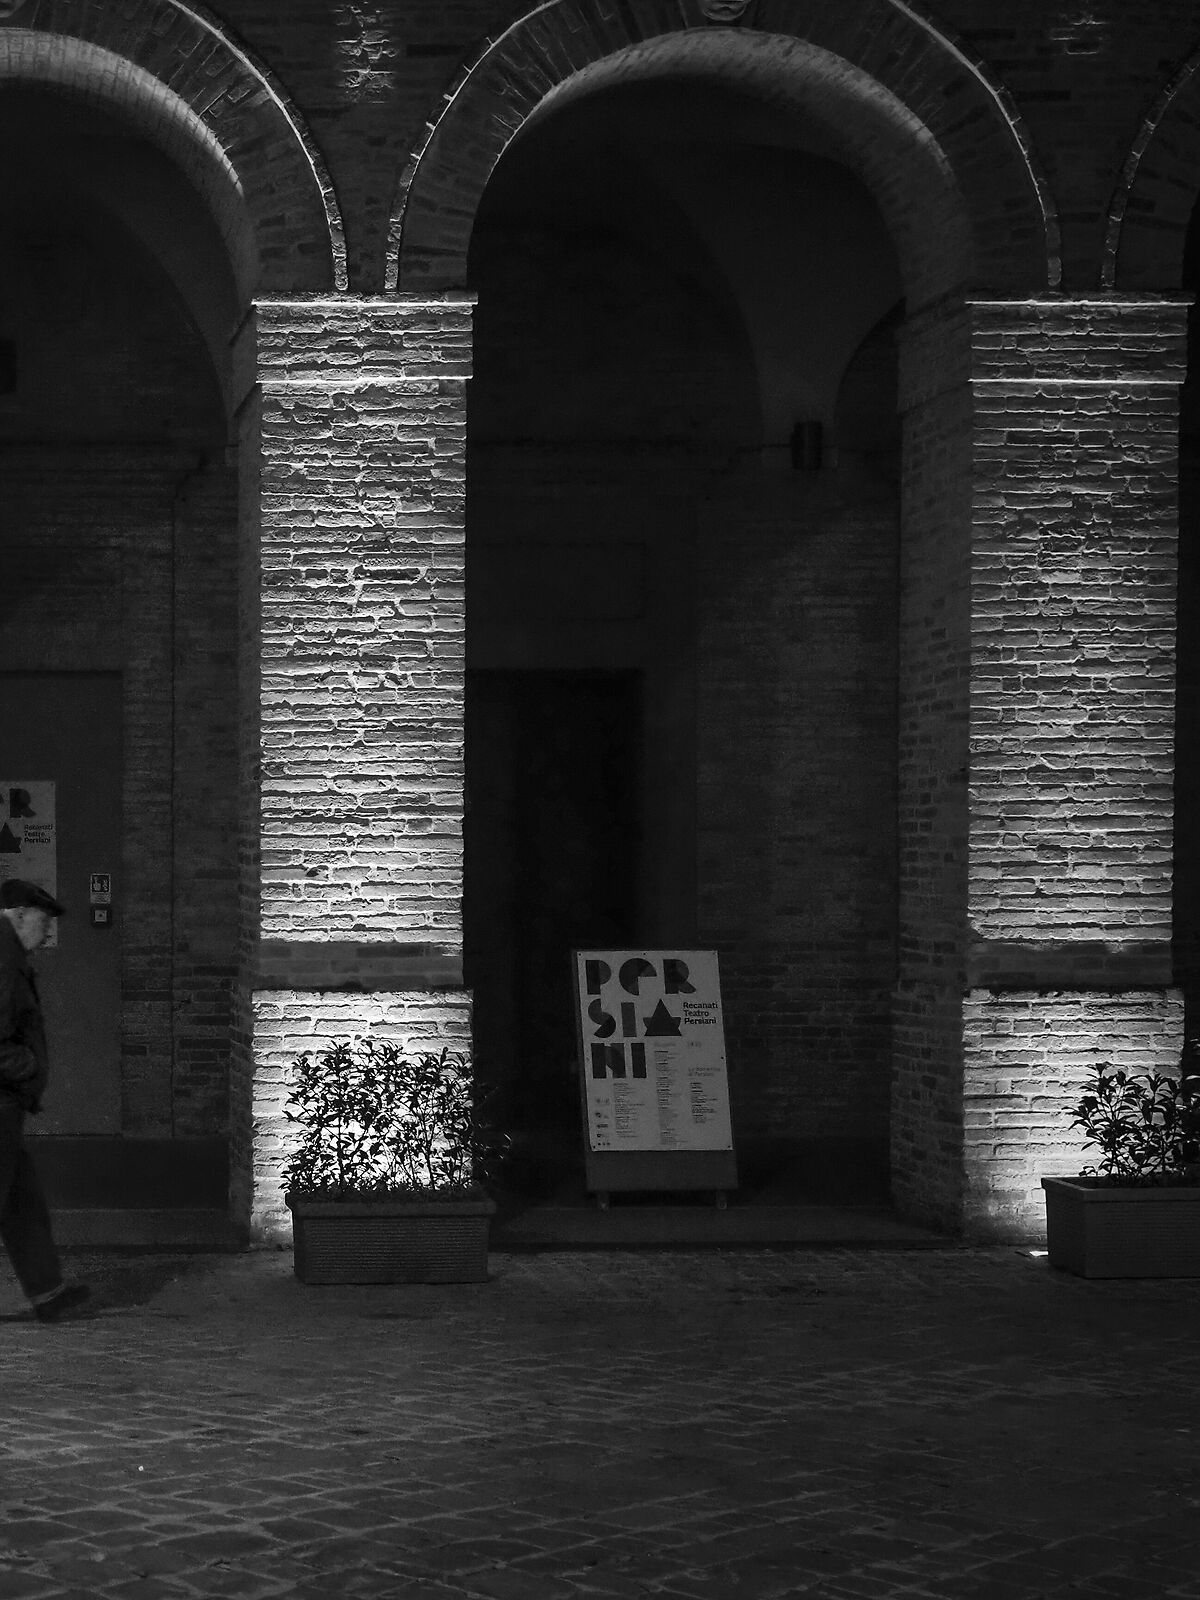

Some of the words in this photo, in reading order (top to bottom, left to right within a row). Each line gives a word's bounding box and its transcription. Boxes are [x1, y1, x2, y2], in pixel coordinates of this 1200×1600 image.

[683, 1001, 718, 1009] Recanati
[683, 1009, 710, 1017] Teatro
[587, 998, 682, 1039] SIA
[684, 1017, 717, 1025] Persiani
[590, 1042, 648, 1079] NI
